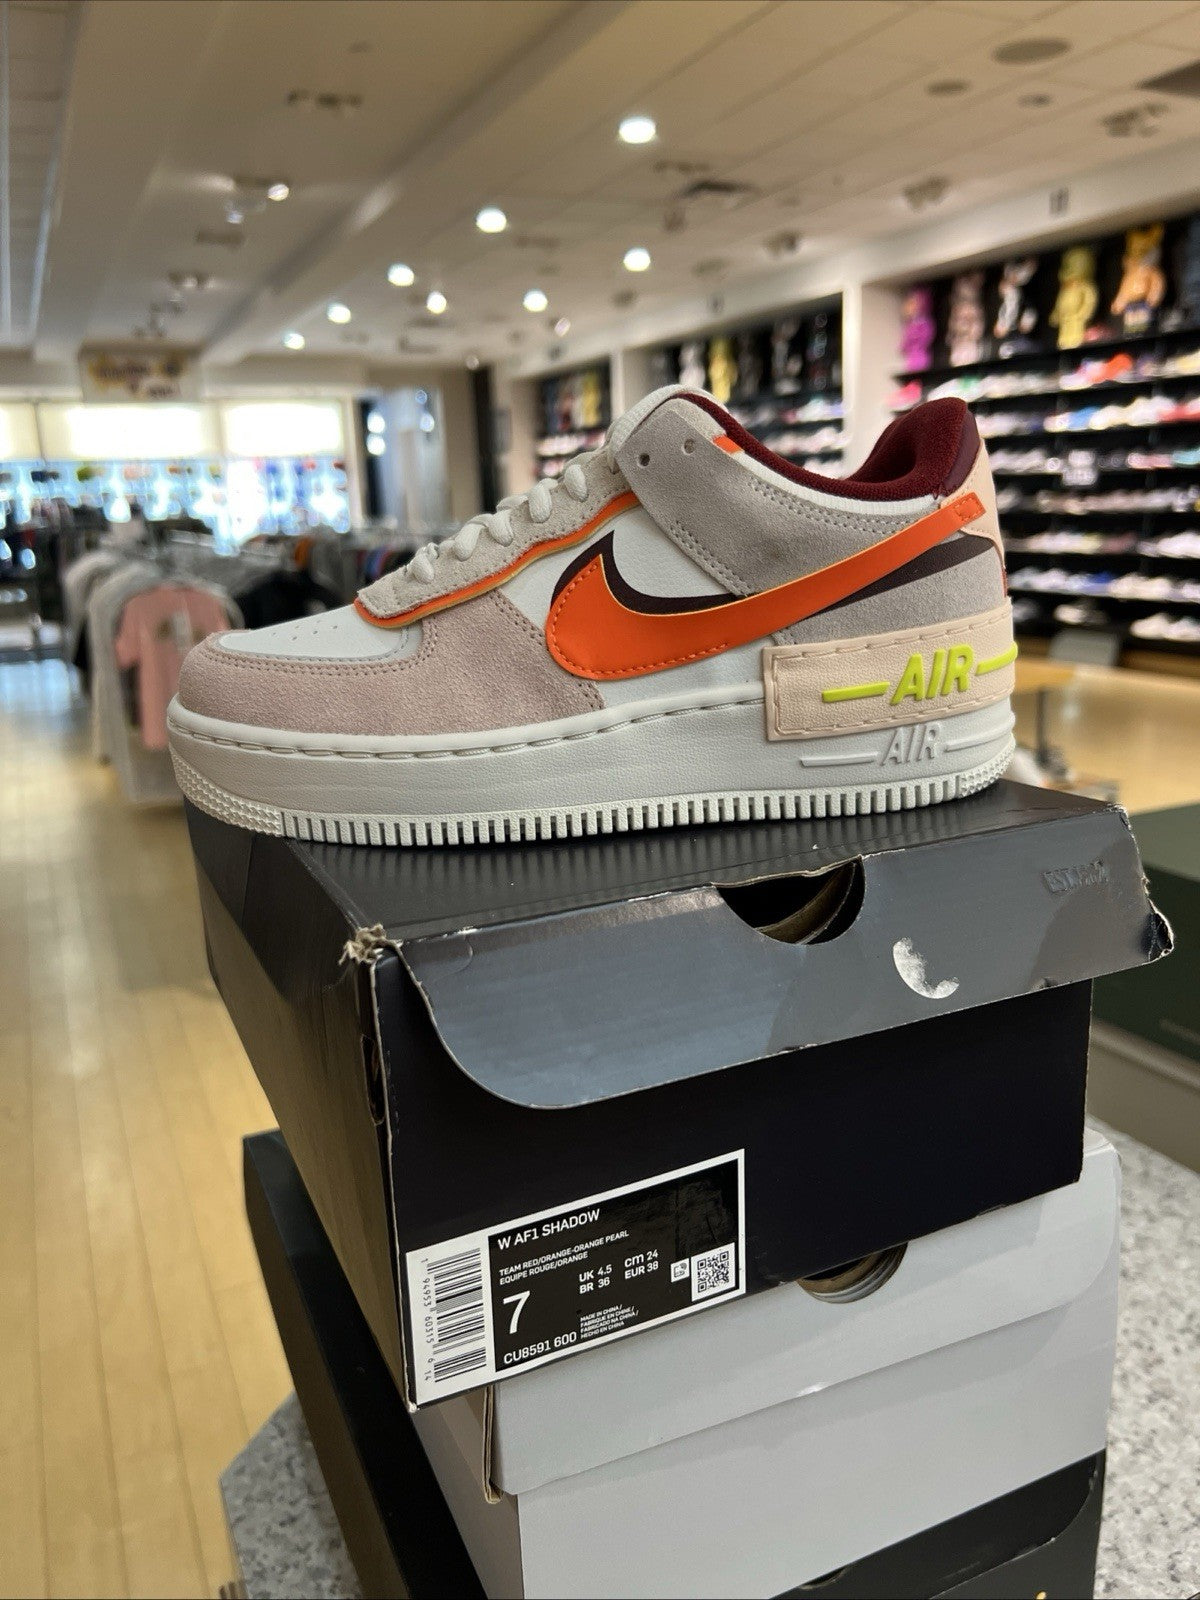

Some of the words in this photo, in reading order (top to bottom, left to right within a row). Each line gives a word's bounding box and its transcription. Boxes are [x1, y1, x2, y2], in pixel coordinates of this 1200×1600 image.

[889, 644, 974, 706] AIR
[880, 721, 941, 766] AIR
[498, 1235, 511, 1250] W
[514, 1228, 540, 1246] AF1
[541, 1209, 600, 1237] SHADOW
[499, 1264, 522, 1277] TEAM
[523, 1238, 605, 1269] RED/ORANGE-ORANGE
[605, 1230, 630, 1243] PEARL
[624, 1254, 644, 1268] cm
[647, 1249, 659, 1261] 24
[500, 1271, 528, 1285] EQUIPE
[529, 1251, 589, 1278] ROUGE/ORANGE
[579, 1271, 594, 1282] UK
[597, 1264, 613, 1276] 4.5
[624, 1265, 646, 1280] EUR
[647, 1261, 659, 1273] 38
[580, 1283, 594, 1294] BR
[598, 1277, 611, 1288] 36
[502, 1290, 531, 1335] 7
[580, 1313, 596, 1322] MADE
[580, 1316, 606, 1328] FABRIQUE
[580, 1321, 610, 1333] FABRICADO
[580, 1329, 600, 1339] HECHO
[608, 1321, 625, 1330] CHINA
[503, 1340, 551, 1365] CU8591
[553, 1331, 578, 1349] 600
